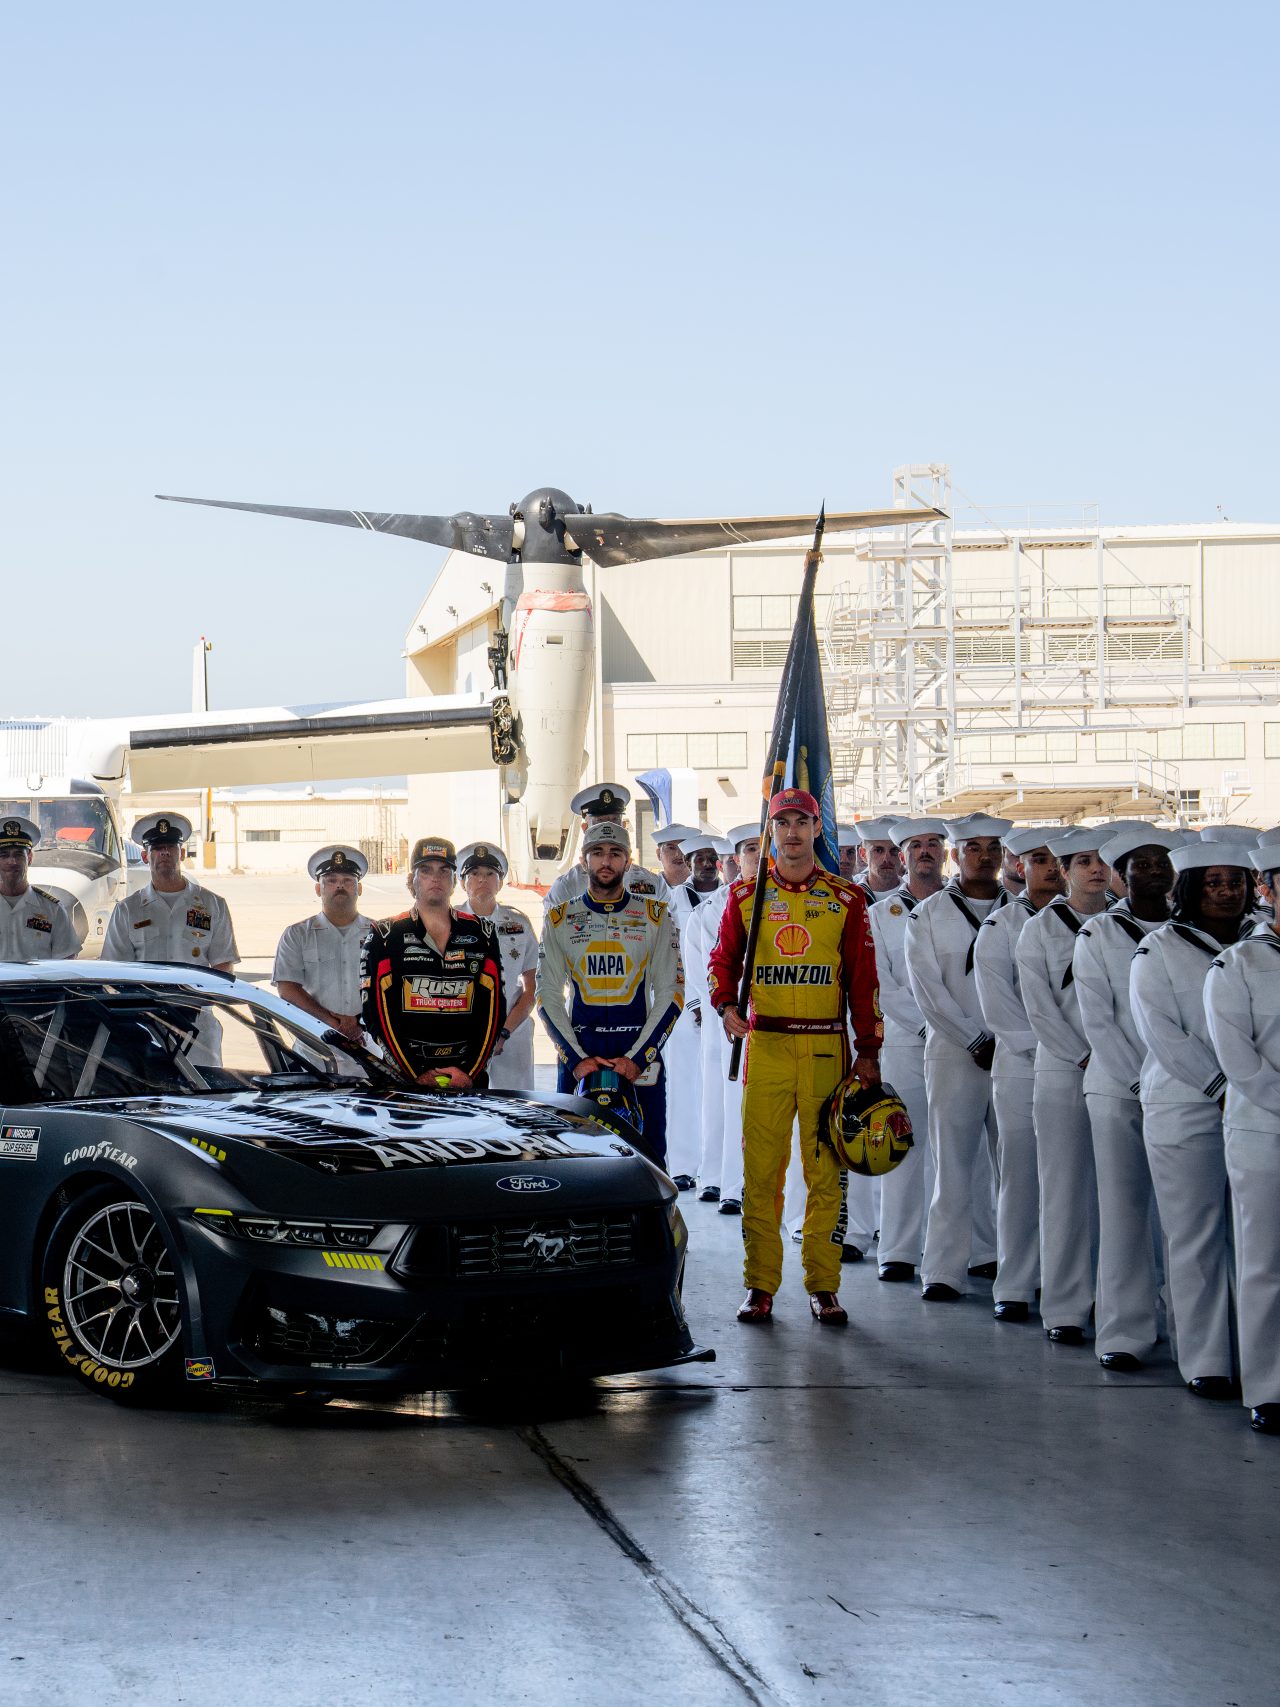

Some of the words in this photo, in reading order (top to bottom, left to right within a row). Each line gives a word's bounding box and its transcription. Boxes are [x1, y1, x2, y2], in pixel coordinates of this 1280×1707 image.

[587, 954, 625, 976] NAPA
[755, 965, 834, 986] PENNZOIL
[63, 1140, 138, 1170] GOODYEAR
[510, 1177, 550, 1190] Ford
[44, 1286, 135, 1388] GOODYEAR
